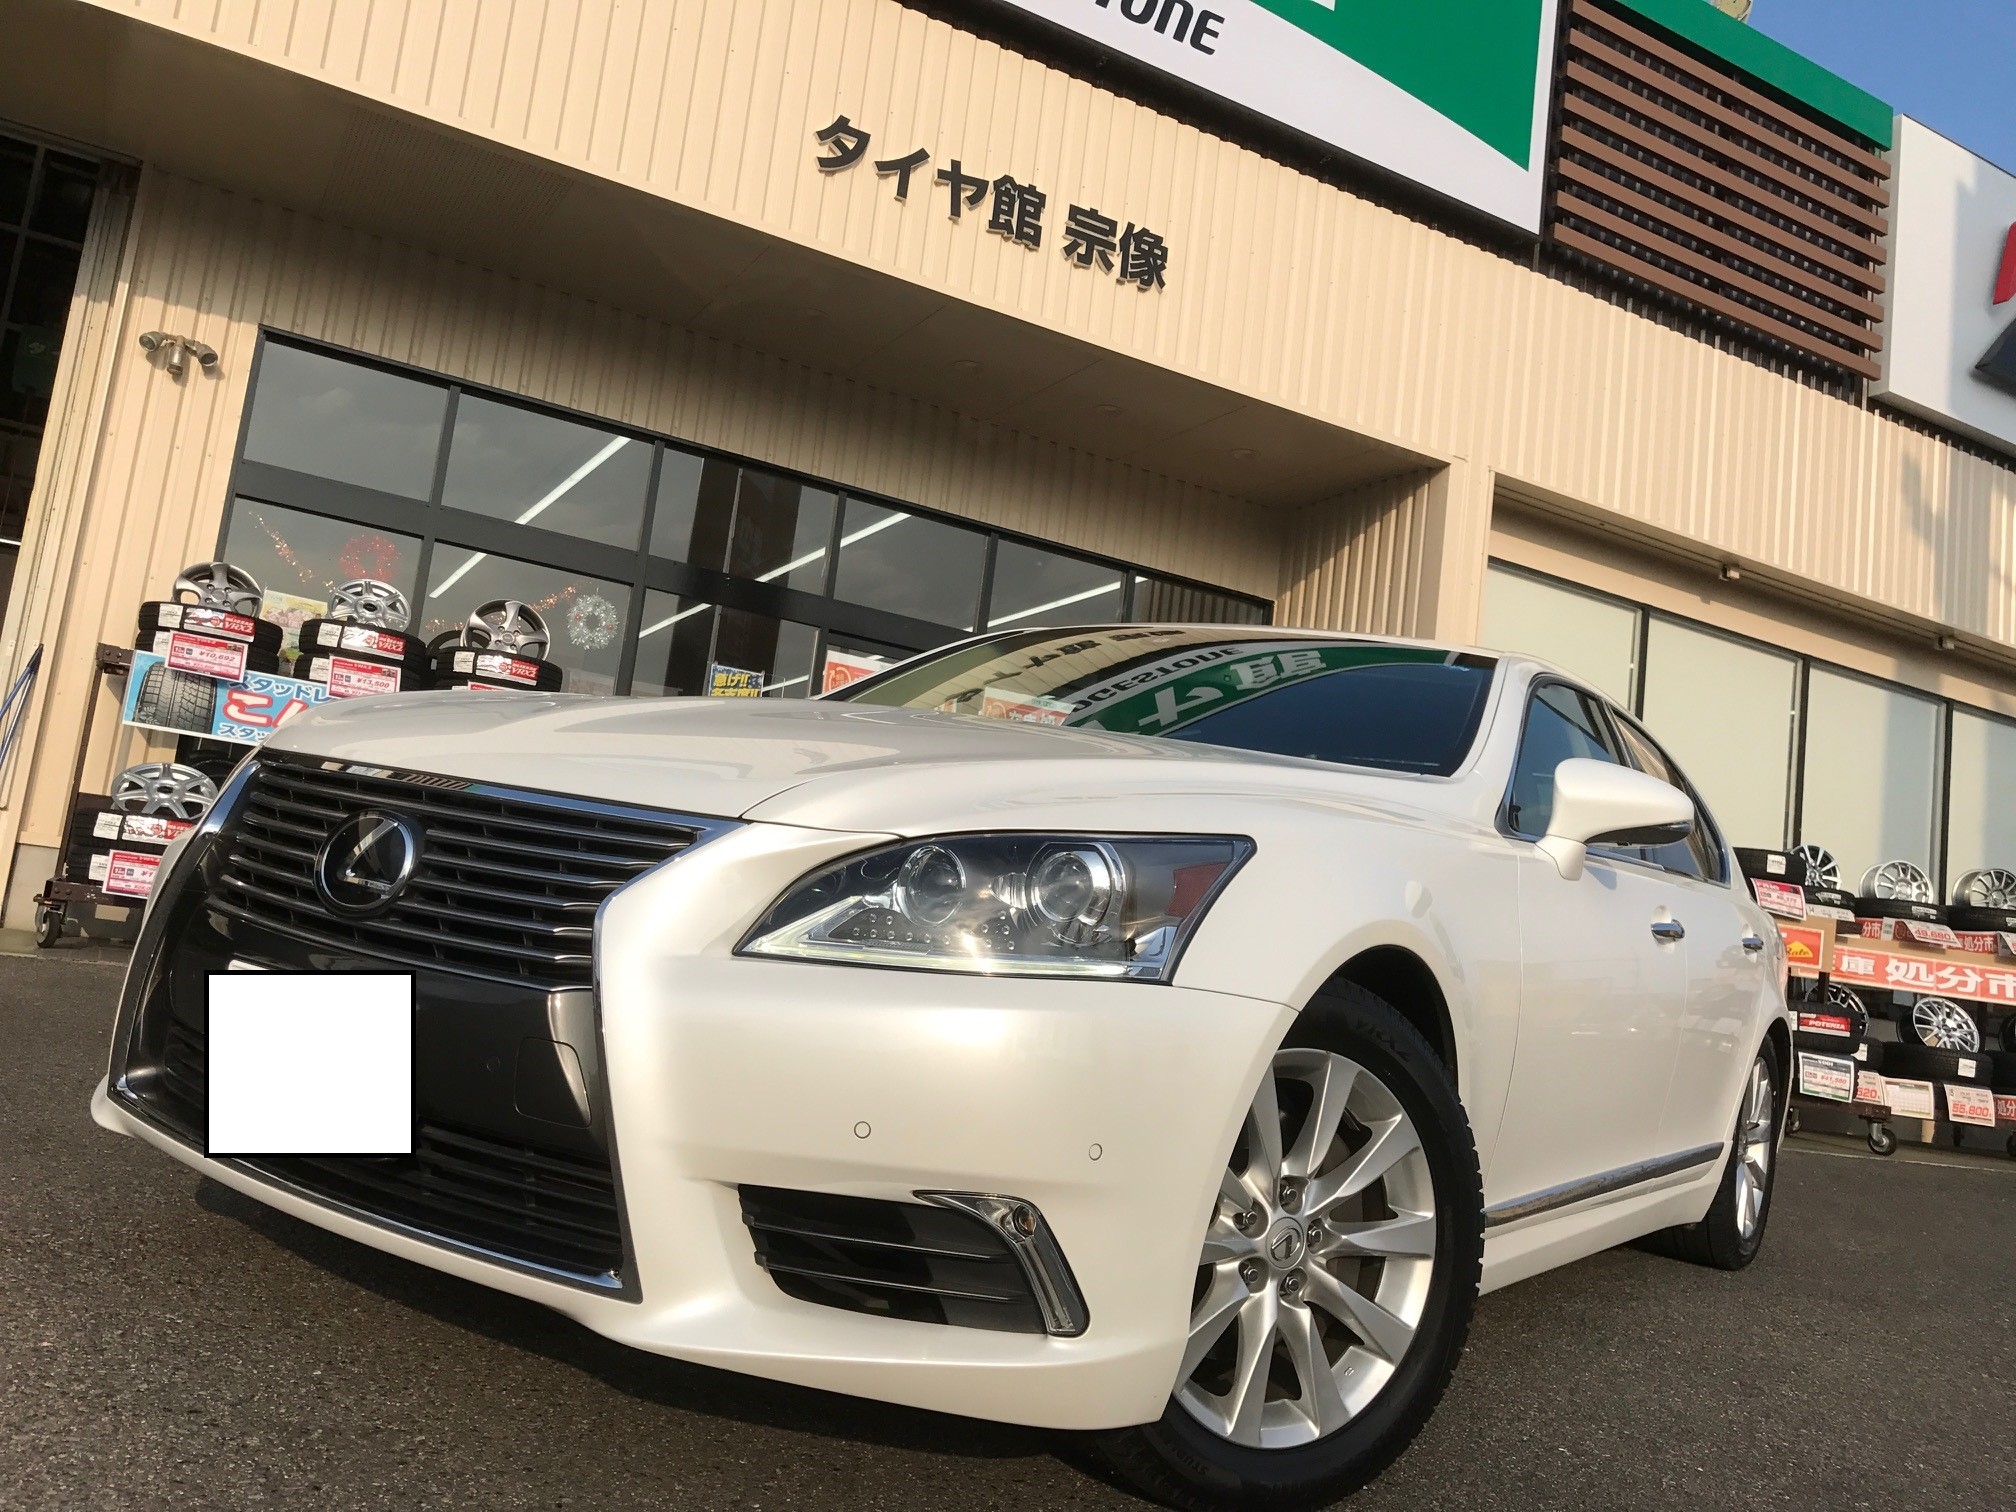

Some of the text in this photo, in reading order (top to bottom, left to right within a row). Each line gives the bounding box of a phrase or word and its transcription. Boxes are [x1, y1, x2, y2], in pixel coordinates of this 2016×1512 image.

[1095, 0, 1225, 55] ONE
[814, 114, 1170, 293] タイヤ館 宗像
[225, 621, 253, 633] VRX2
[1833, 953, 2016, 999] 庫処分市
[1808, 1020, 1846, 1030] POTENZA
